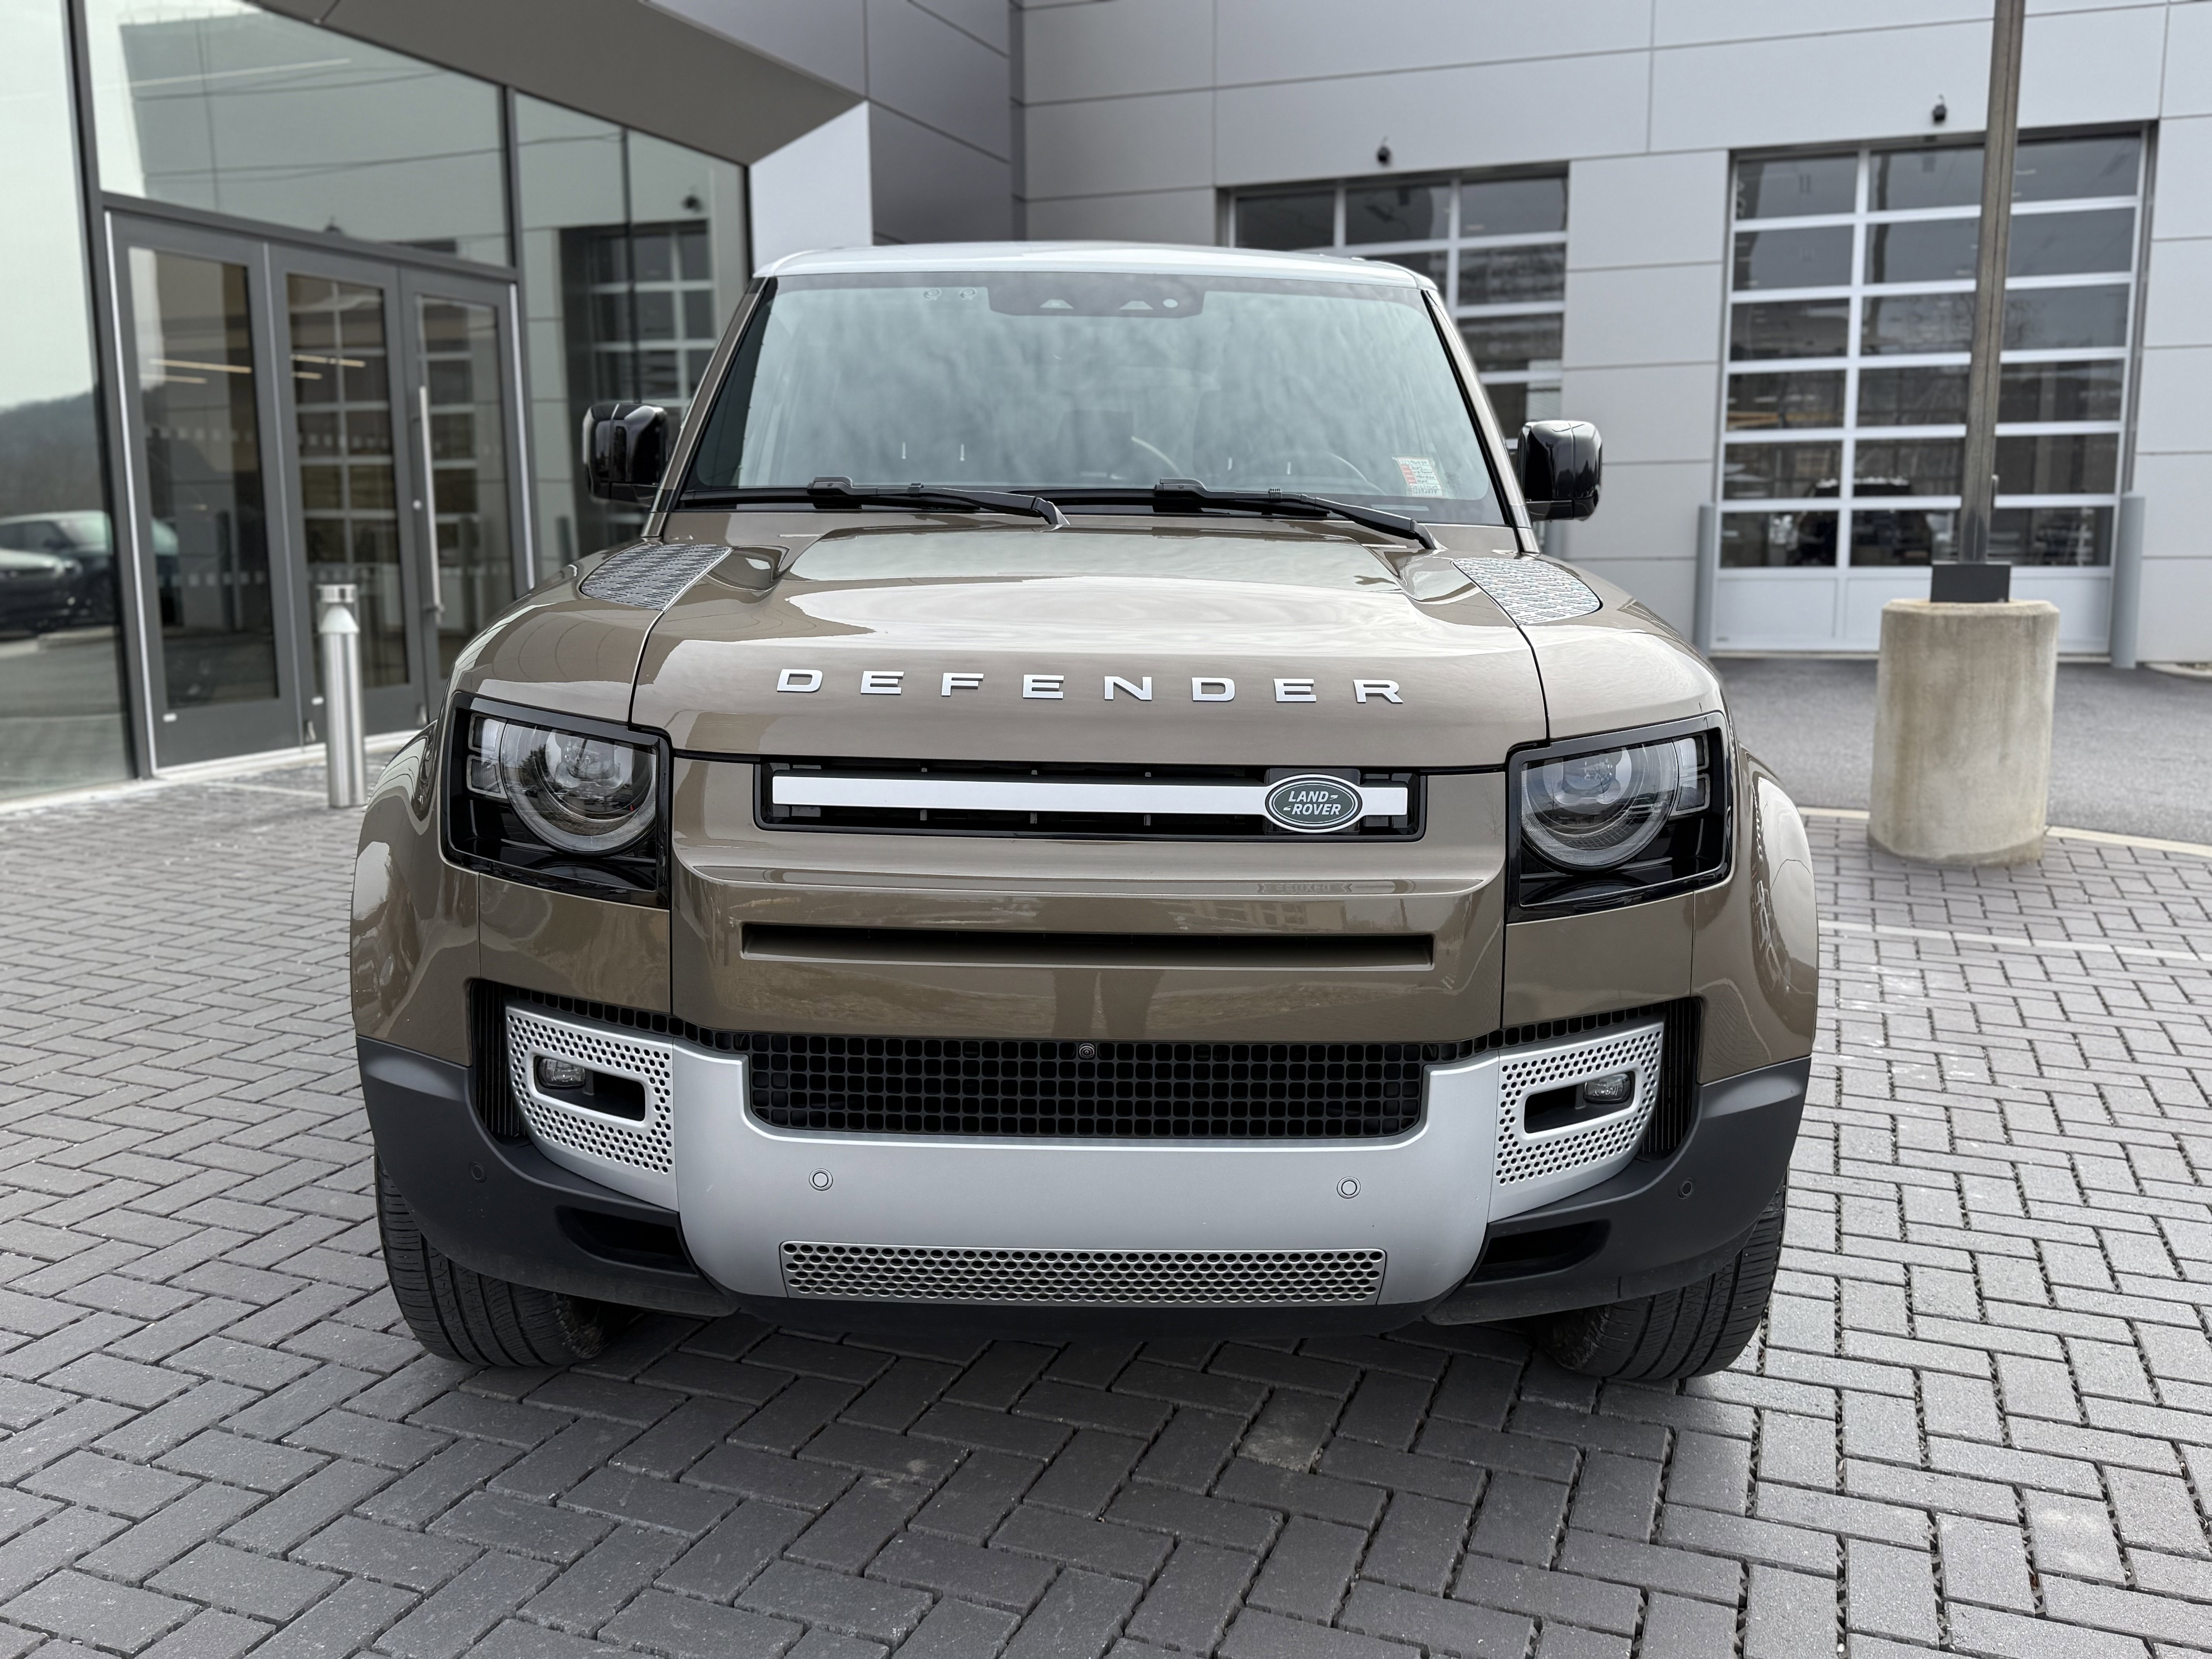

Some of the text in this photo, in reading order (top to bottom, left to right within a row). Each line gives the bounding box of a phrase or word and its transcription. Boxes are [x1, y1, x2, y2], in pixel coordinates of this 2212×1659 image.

[777, 669, 1404, 703] DEFENDER
[1288, 791, 1329, 802] LAND
[1291, 804, 1341, 815] ROVER
